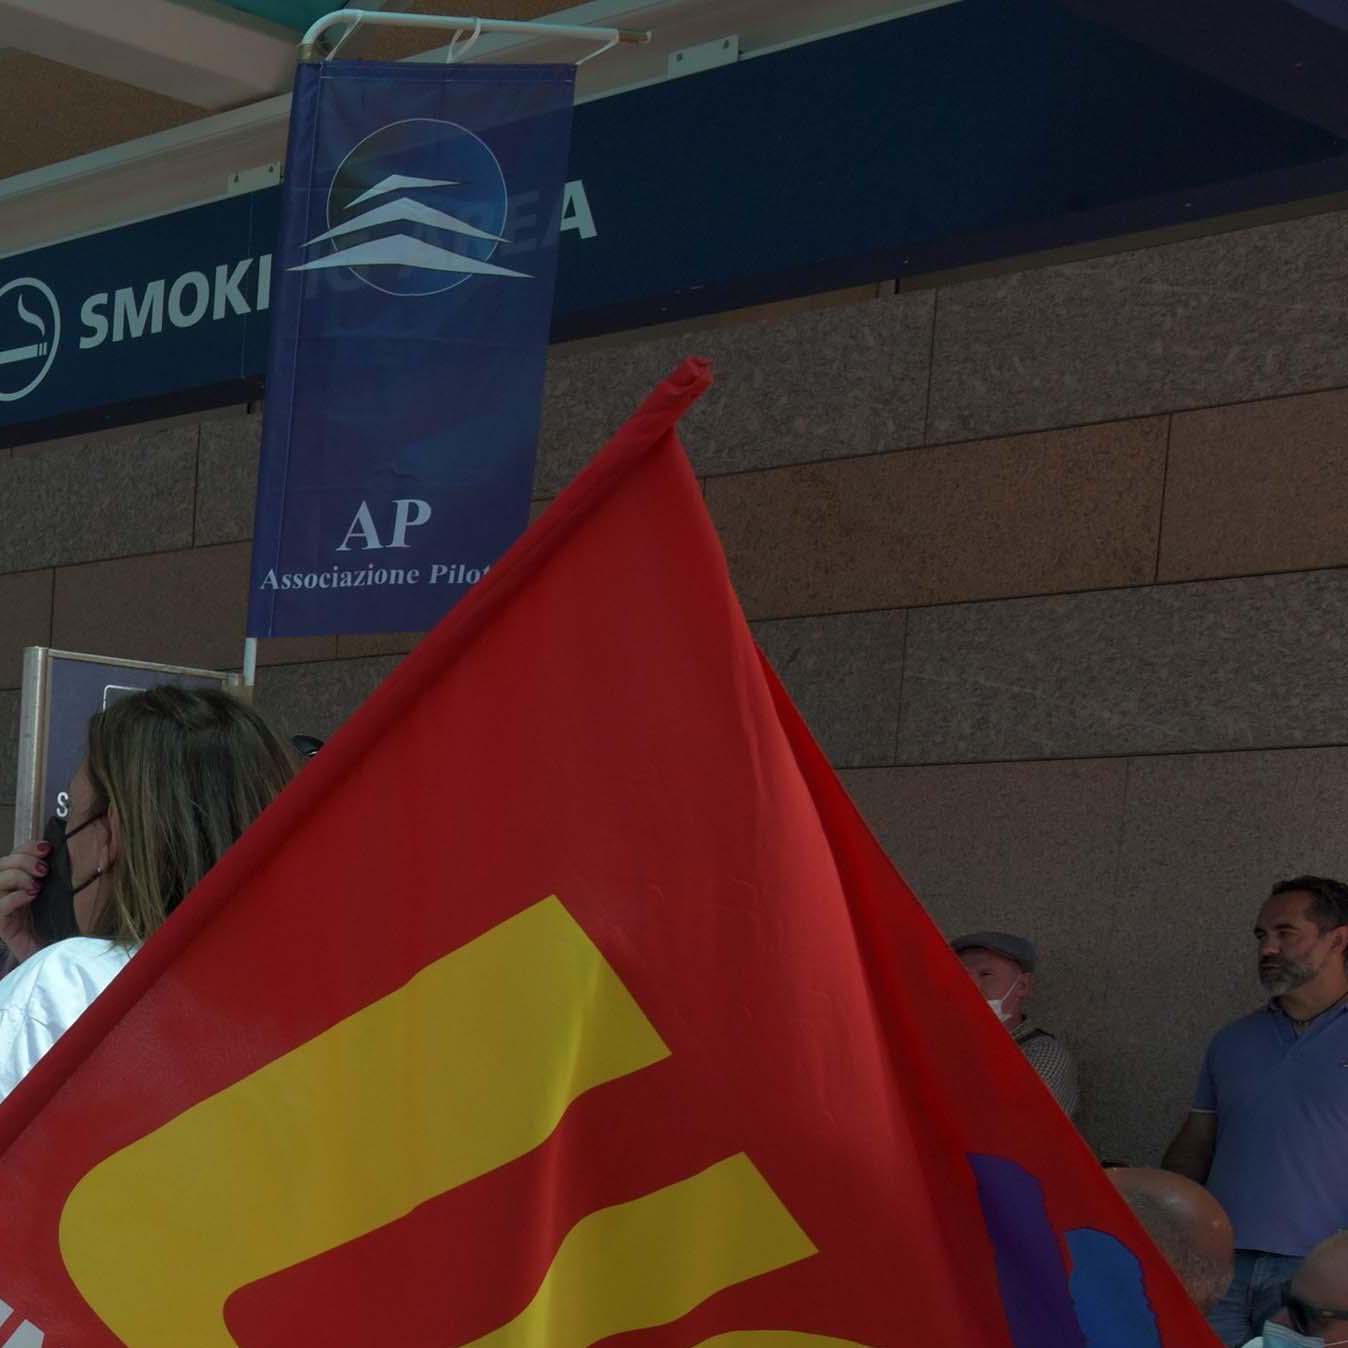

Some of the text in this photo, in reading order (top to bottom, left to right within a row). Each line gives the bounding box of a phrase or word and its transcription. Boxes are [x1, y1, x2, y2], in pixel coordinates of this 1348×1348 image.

[79, 254, 273, 349] SMOKI
[335, 498, 432, 551] AP
[259, 563, 420, 590] Associazione
